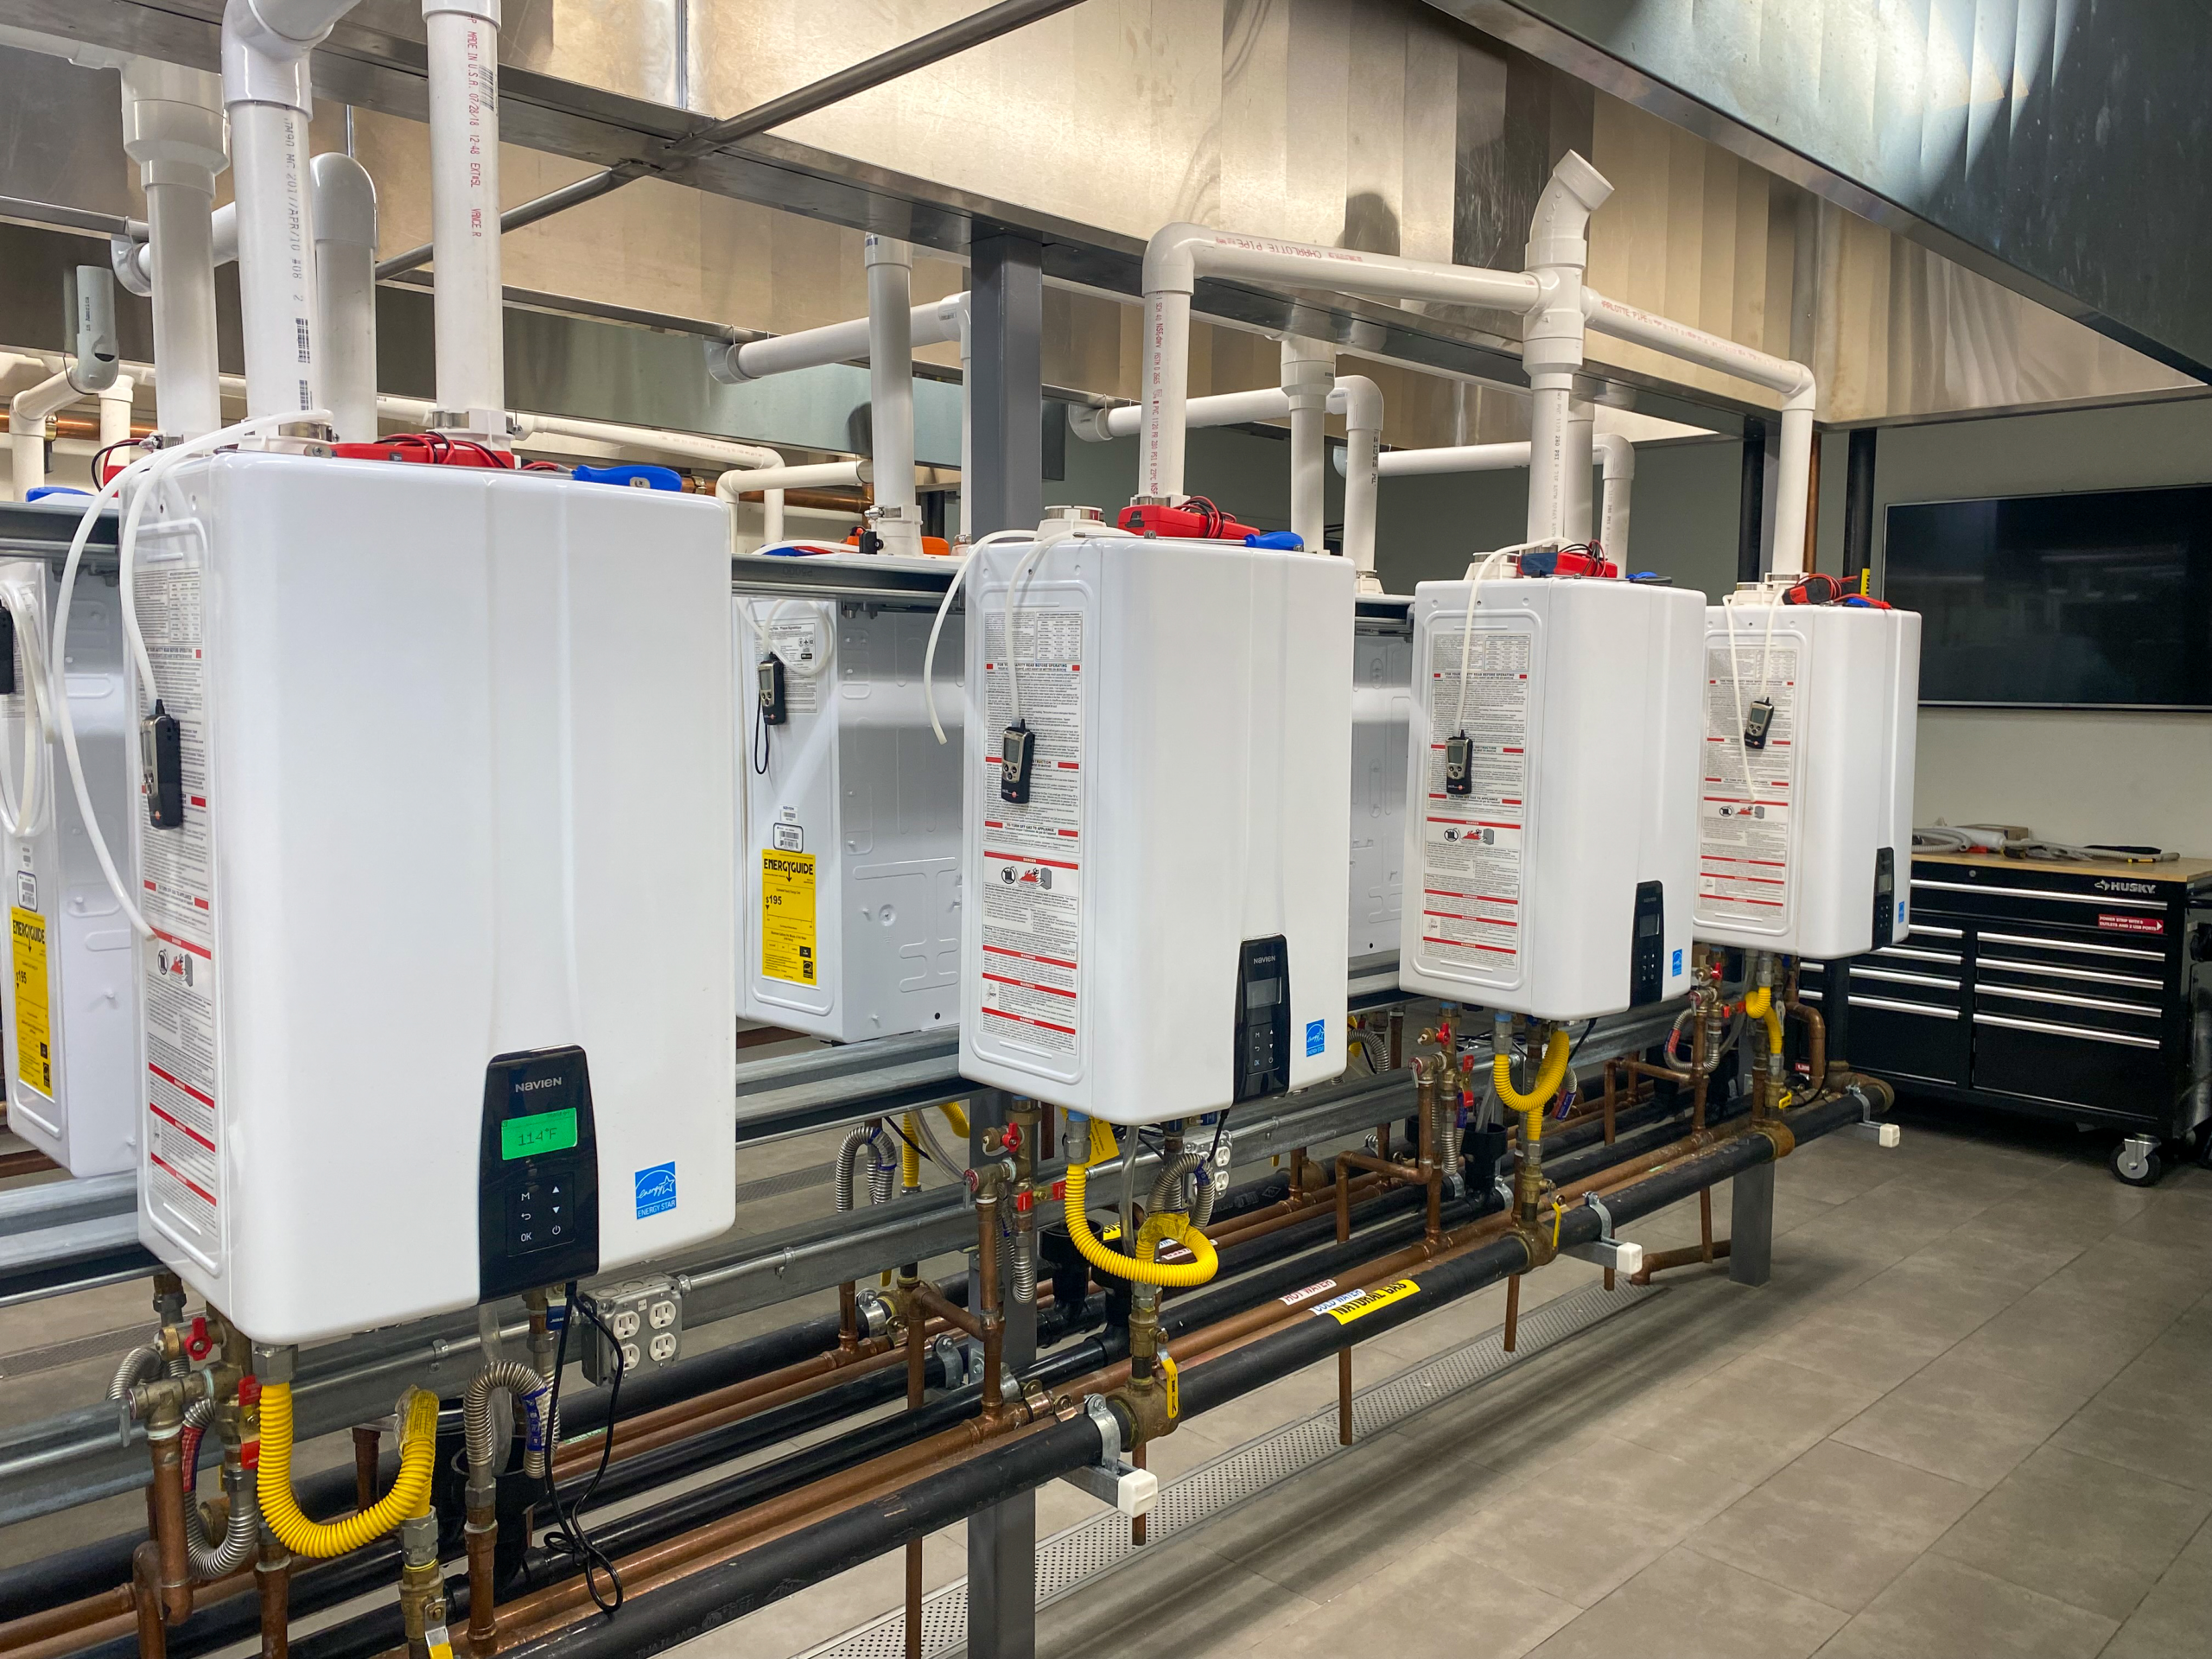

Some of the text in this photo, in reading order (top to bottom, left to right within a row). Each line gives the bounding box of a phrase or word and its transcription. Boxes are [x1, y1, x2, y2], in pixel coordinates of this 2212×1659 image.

[1236, 238, 1262, 251] PIPE
[1267, 243, 1322, 259] CHARLOTTE
[763, 858, 814, 876] ENERGYGUIDE
[2111, 881, 2157, 894] HUSKY
[766, 894, 783, 906] $195
[12, 919, 46, 945] ENERGYGUIDE
[521, 1192, 531, 1202] M
[638, 1199, 676, 1217] ENERGY STAR
[520, 1232, 532, 1243] OK
[1303, 1280, 1334, 1295] WATER
[1333, 1292, 1387, 1316] NATURAL
[1337, 1289, 1363, 1305] WATER
